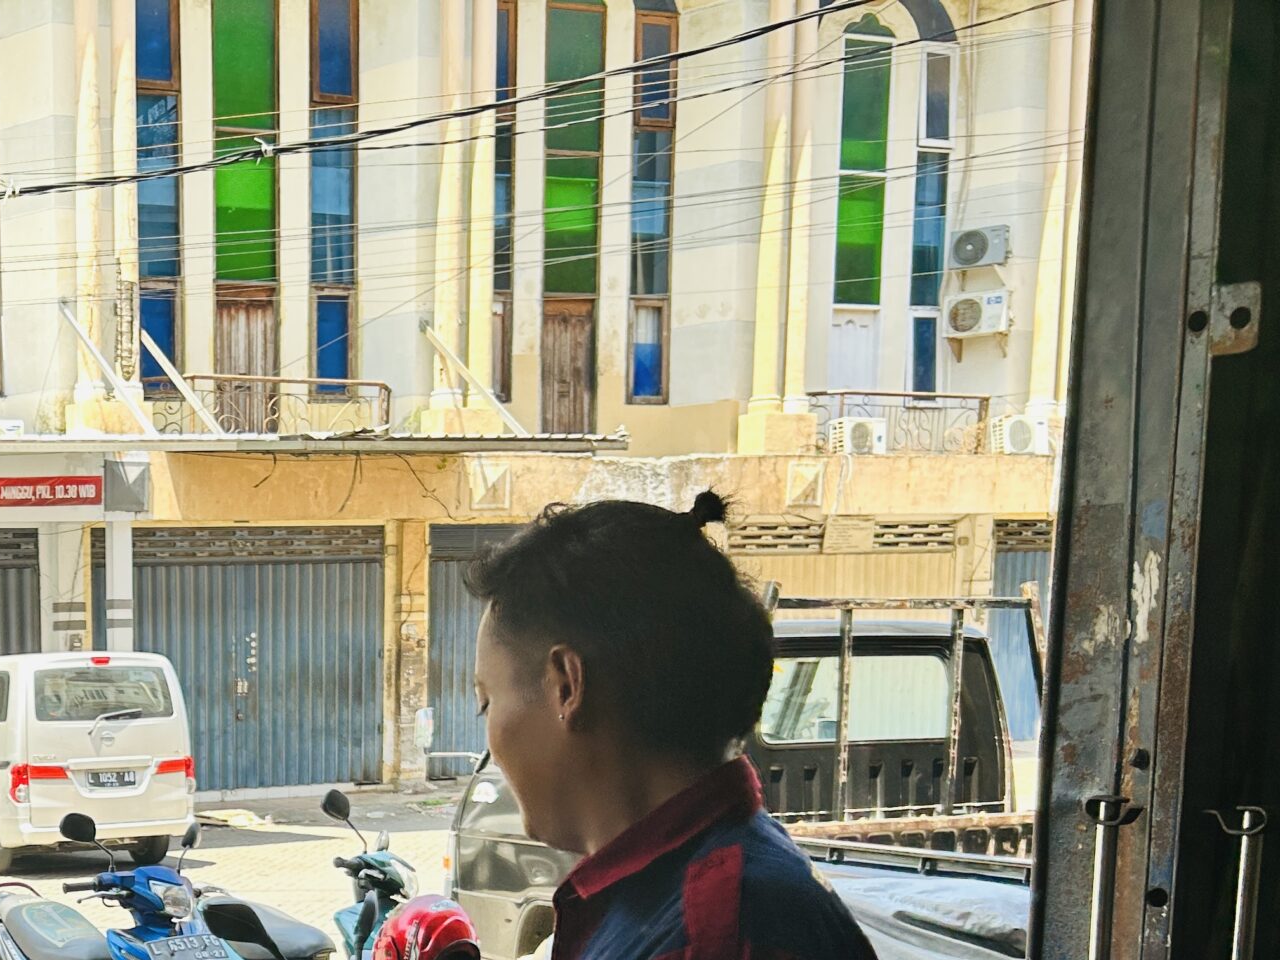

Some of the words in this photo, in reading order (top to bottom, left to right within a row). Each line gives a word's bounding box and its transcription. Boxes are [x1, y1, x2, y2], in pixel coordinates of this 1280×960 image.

[79, 484, 96, 498] WIB
[89, 773, 95, 783] L
[150, 943, 161, 955] L
[167, 936, 198, 952] 6513
